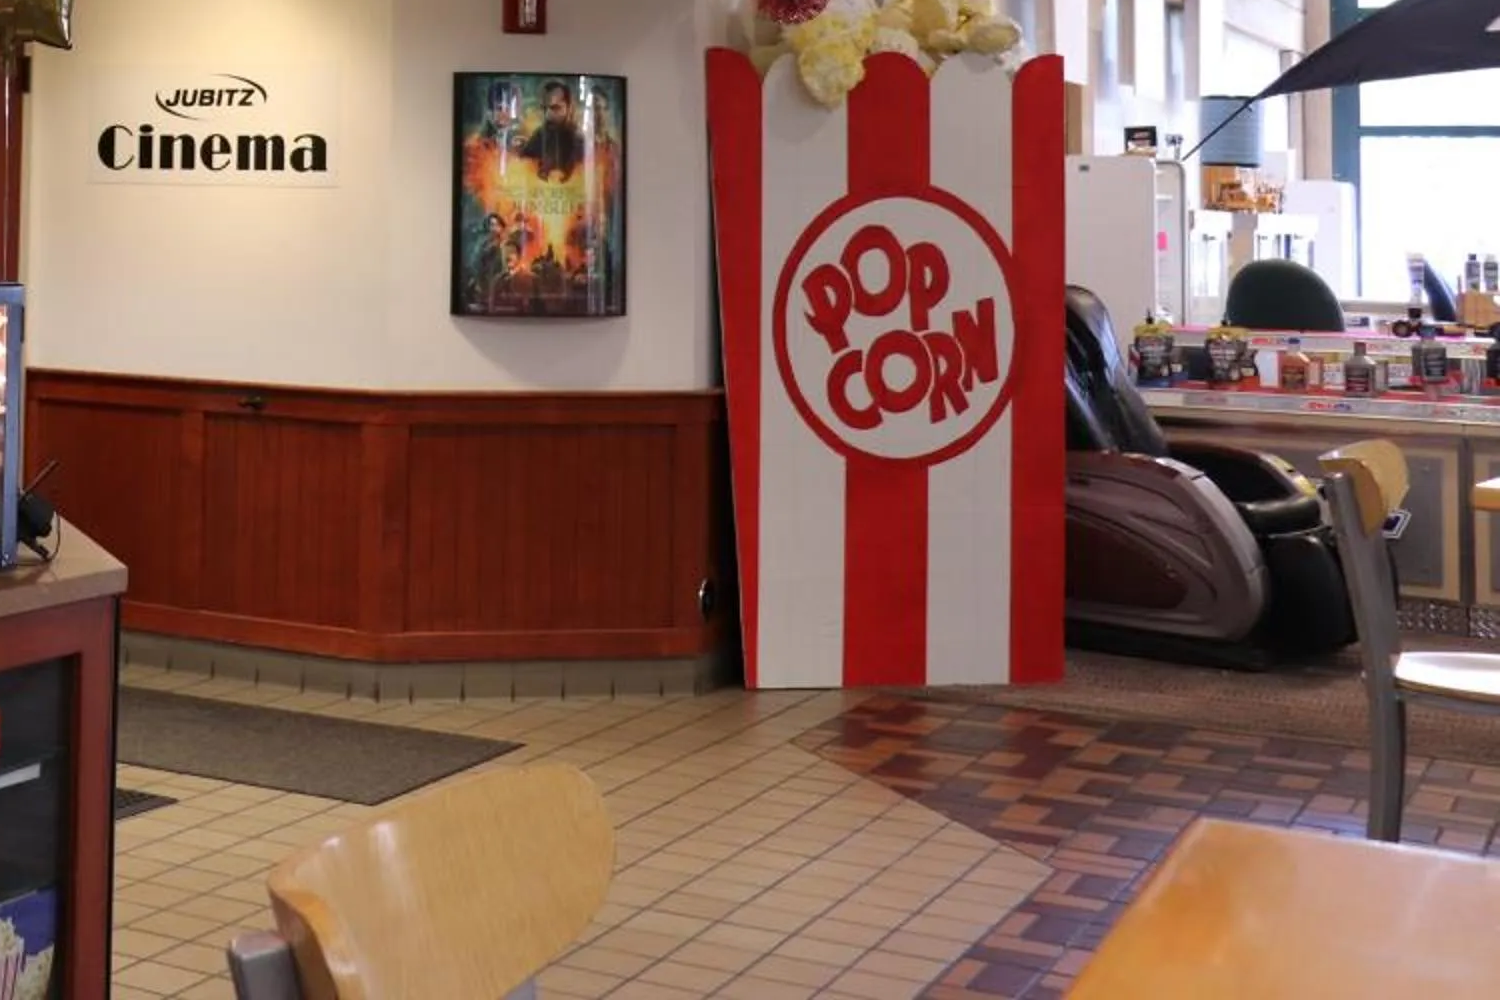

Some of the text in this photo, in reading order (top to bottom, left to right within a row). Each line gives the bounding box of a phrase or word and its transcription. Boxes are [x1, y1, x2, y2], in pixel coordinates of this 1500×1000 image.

[165, 88, 255, 107] JUBITZ
[99, 124, 328, 173] Cinema
[802, 224, 949, 354] POP
[827, 297, 998, 430] CORN
